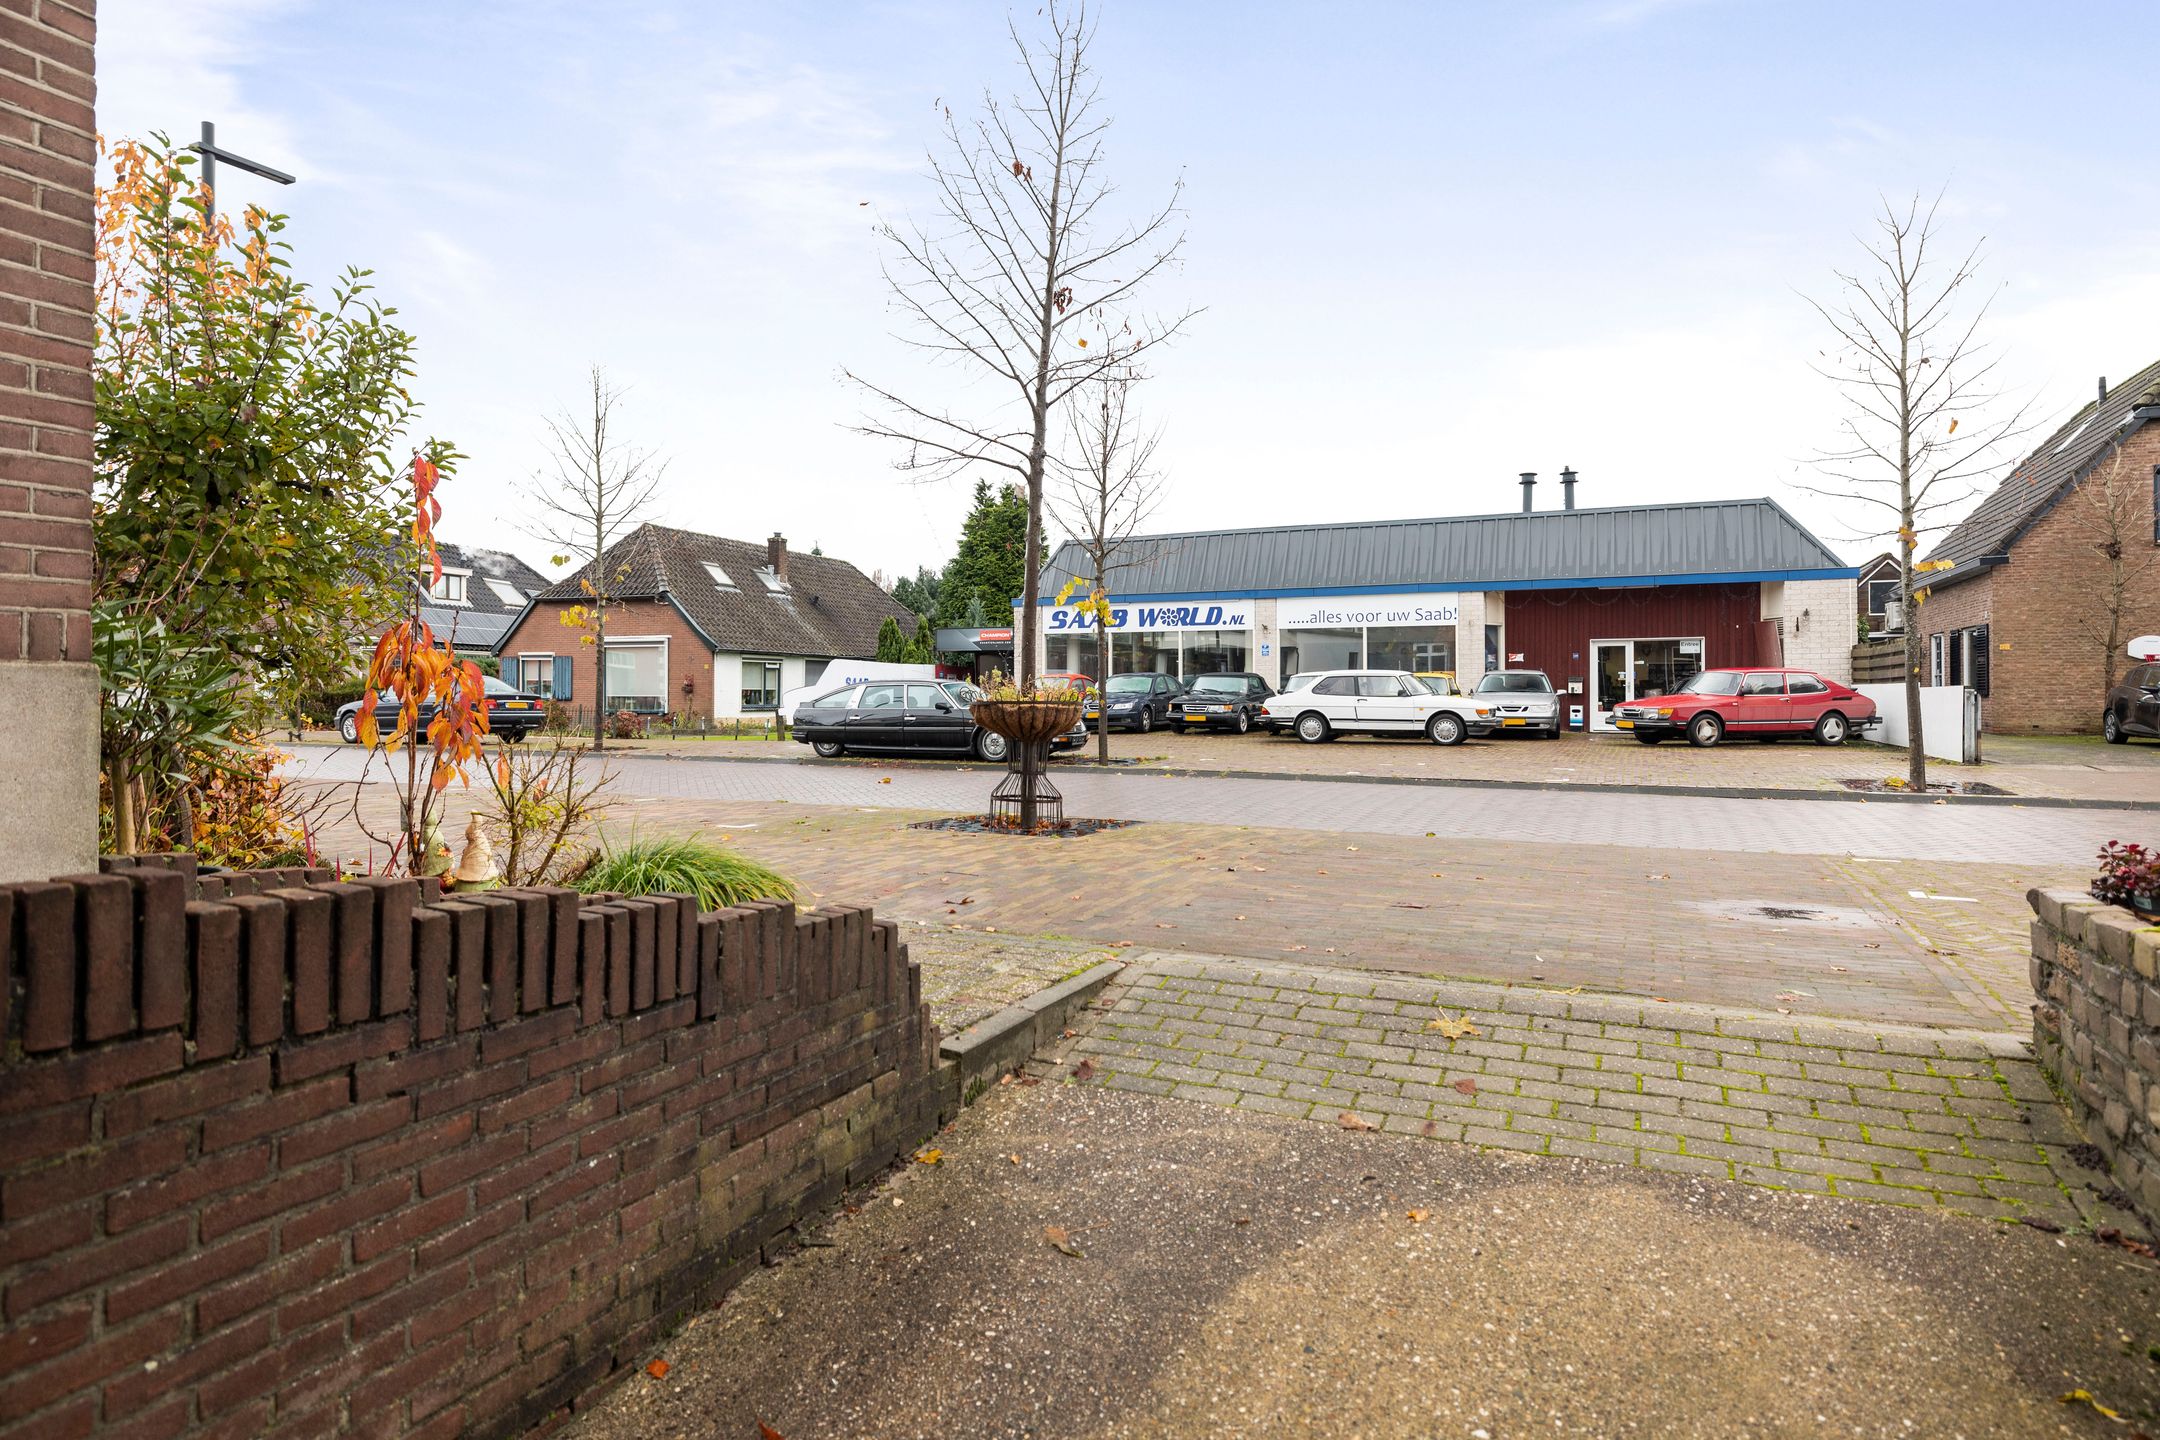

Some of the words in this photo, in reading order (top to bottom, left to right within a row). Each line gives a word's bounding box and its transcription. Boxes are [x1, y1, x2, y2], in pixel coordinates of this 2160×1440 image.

[1346, 611, 1382, 623] voor
[1387, 611, 1410, 622] uw
[1415, 607, 1458, 622] Saab!
